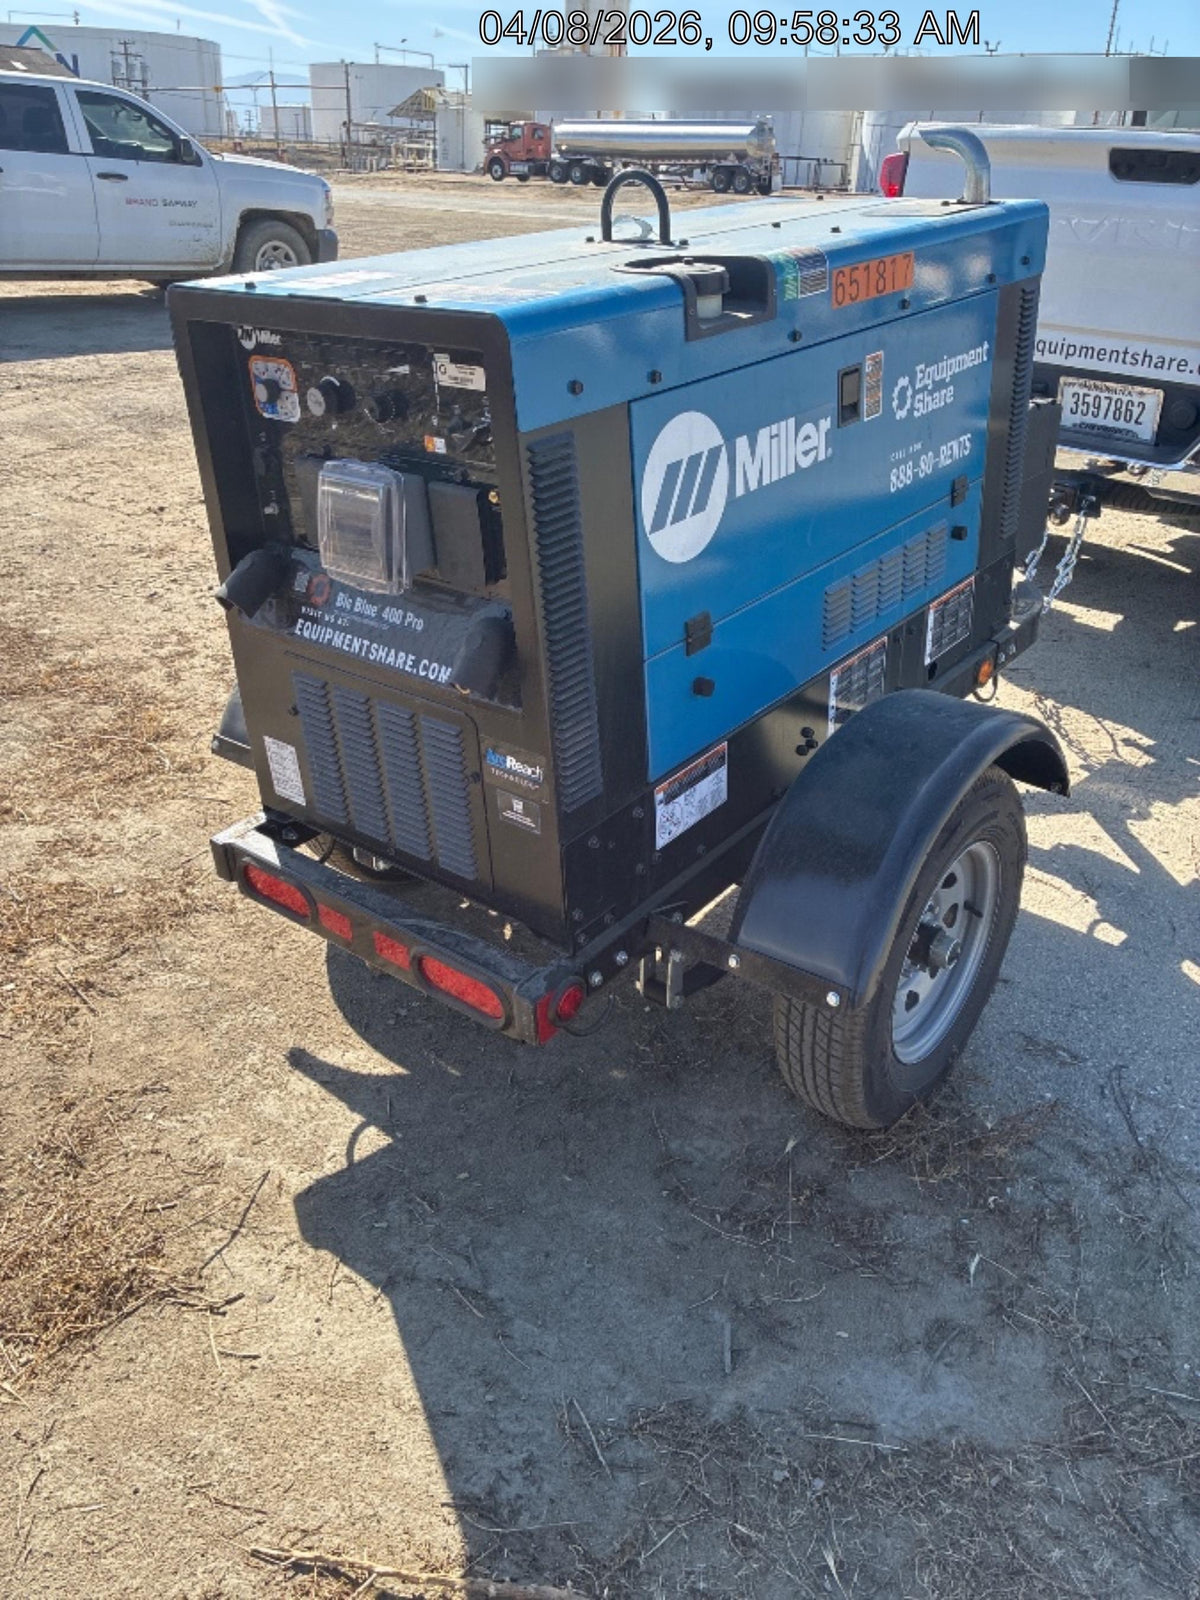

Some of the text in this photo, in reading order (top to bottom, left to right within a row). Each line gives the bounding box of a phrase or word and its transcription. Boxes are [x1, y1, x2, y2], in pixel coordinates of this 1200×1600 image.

[834, 253, 912, 307] 651817
[914, 340, 990, 391] Equipment
[913, 385, 954, 418] Share
[1070, 391, 1146, 426] 3597862
[735, 415, 832, 498] Miller
[890, 432, 972, 493] 888-80-RENTS
[354, 596, 379, 618] Blue
[381, 605, 403, 625] 400
[404, 611, 424, 632] Pro
[294, 617, 453, 684] EQUIPMENTSHARE.COM
